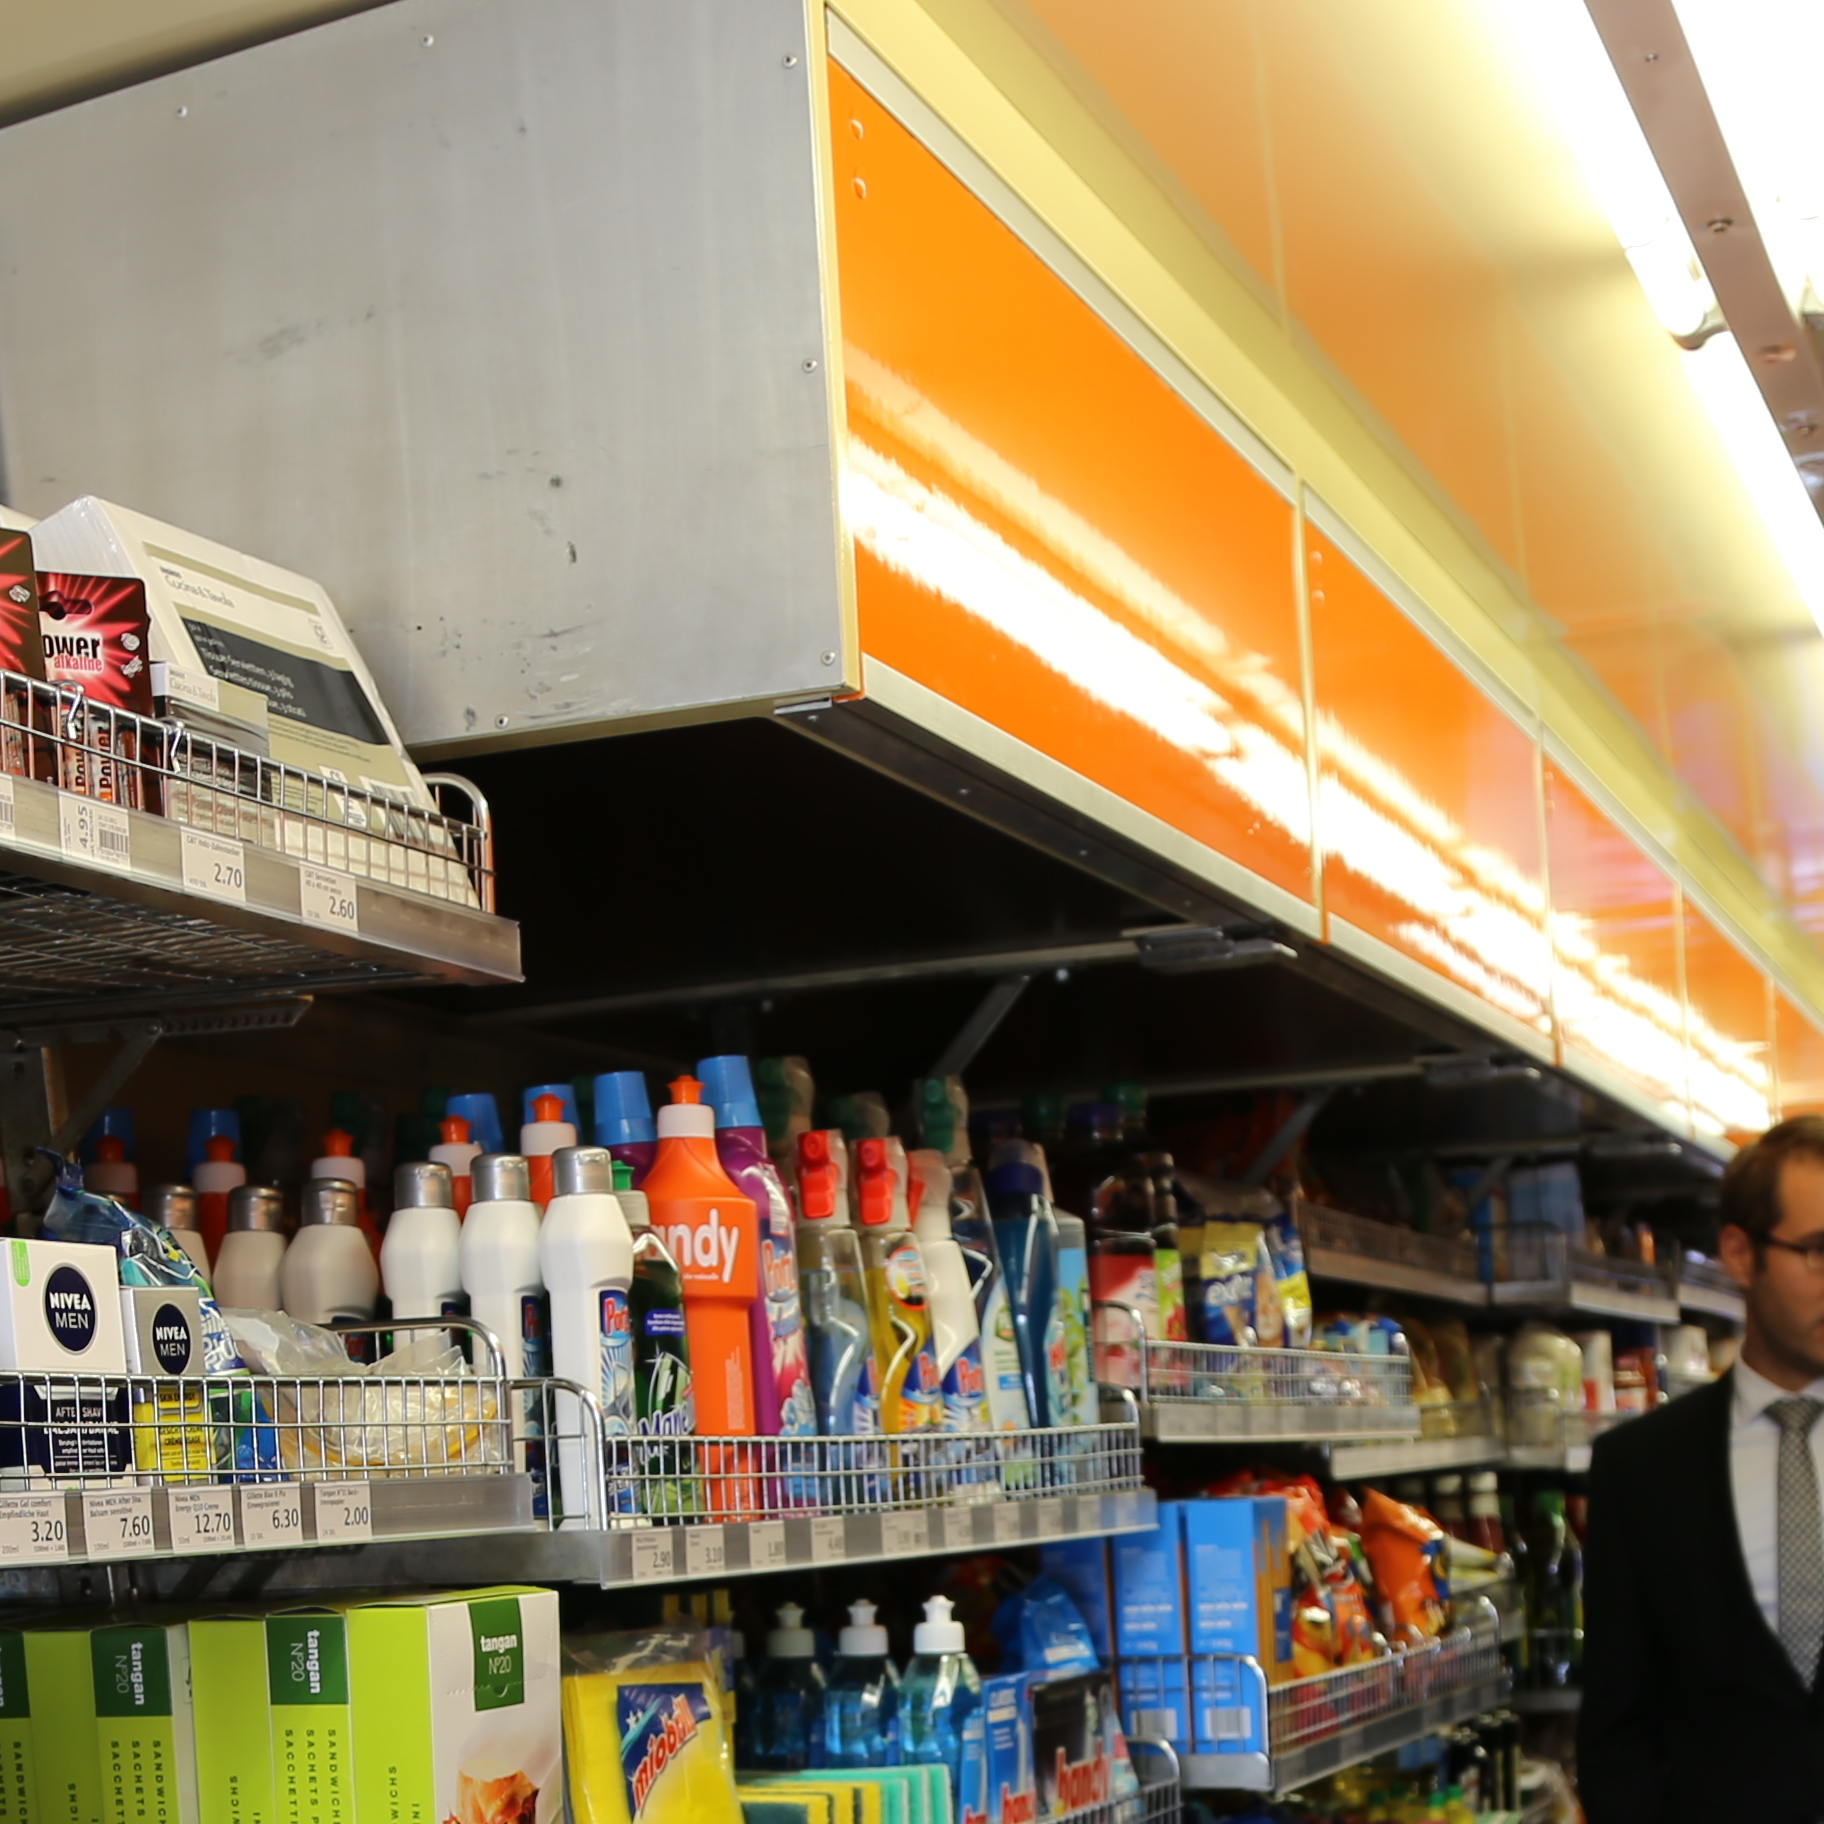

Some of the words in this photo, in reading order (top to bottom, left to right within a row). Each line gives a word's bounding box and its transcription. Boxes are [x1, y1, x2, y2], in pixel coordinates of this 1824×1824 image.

[54, 655, 102, 671] alkaline
[213, 863, 242, 888] 2.70
[329, 896, 355, 920] 2.60
[49, 1292, 91, 1310] NIVEA
[55, 1312, 89, 1329] MEN
[155, 1326, 187, 1341] NIVEA
[160, 1343, 186, 1356] MEN
[119, 1515, 151, 1539] 7.60
[194, 1512, 231, 1535] 12.70
[272, 1508, 299, 1529] 6.30
[343, 1505, 369, 1528] 2.00
[30, 1520, 64, 1543] 3.20
[653, 1550, 671, 1569] 2.90
[480, 1633, 518, 1653] tangan
[305, 1629, 322, 1694] tangan
[129, 1641, 145, 1706] tangan
[131, 1739, 145, 1817] SACHETS
[305, 1728, 319, 1807] SACHETS
